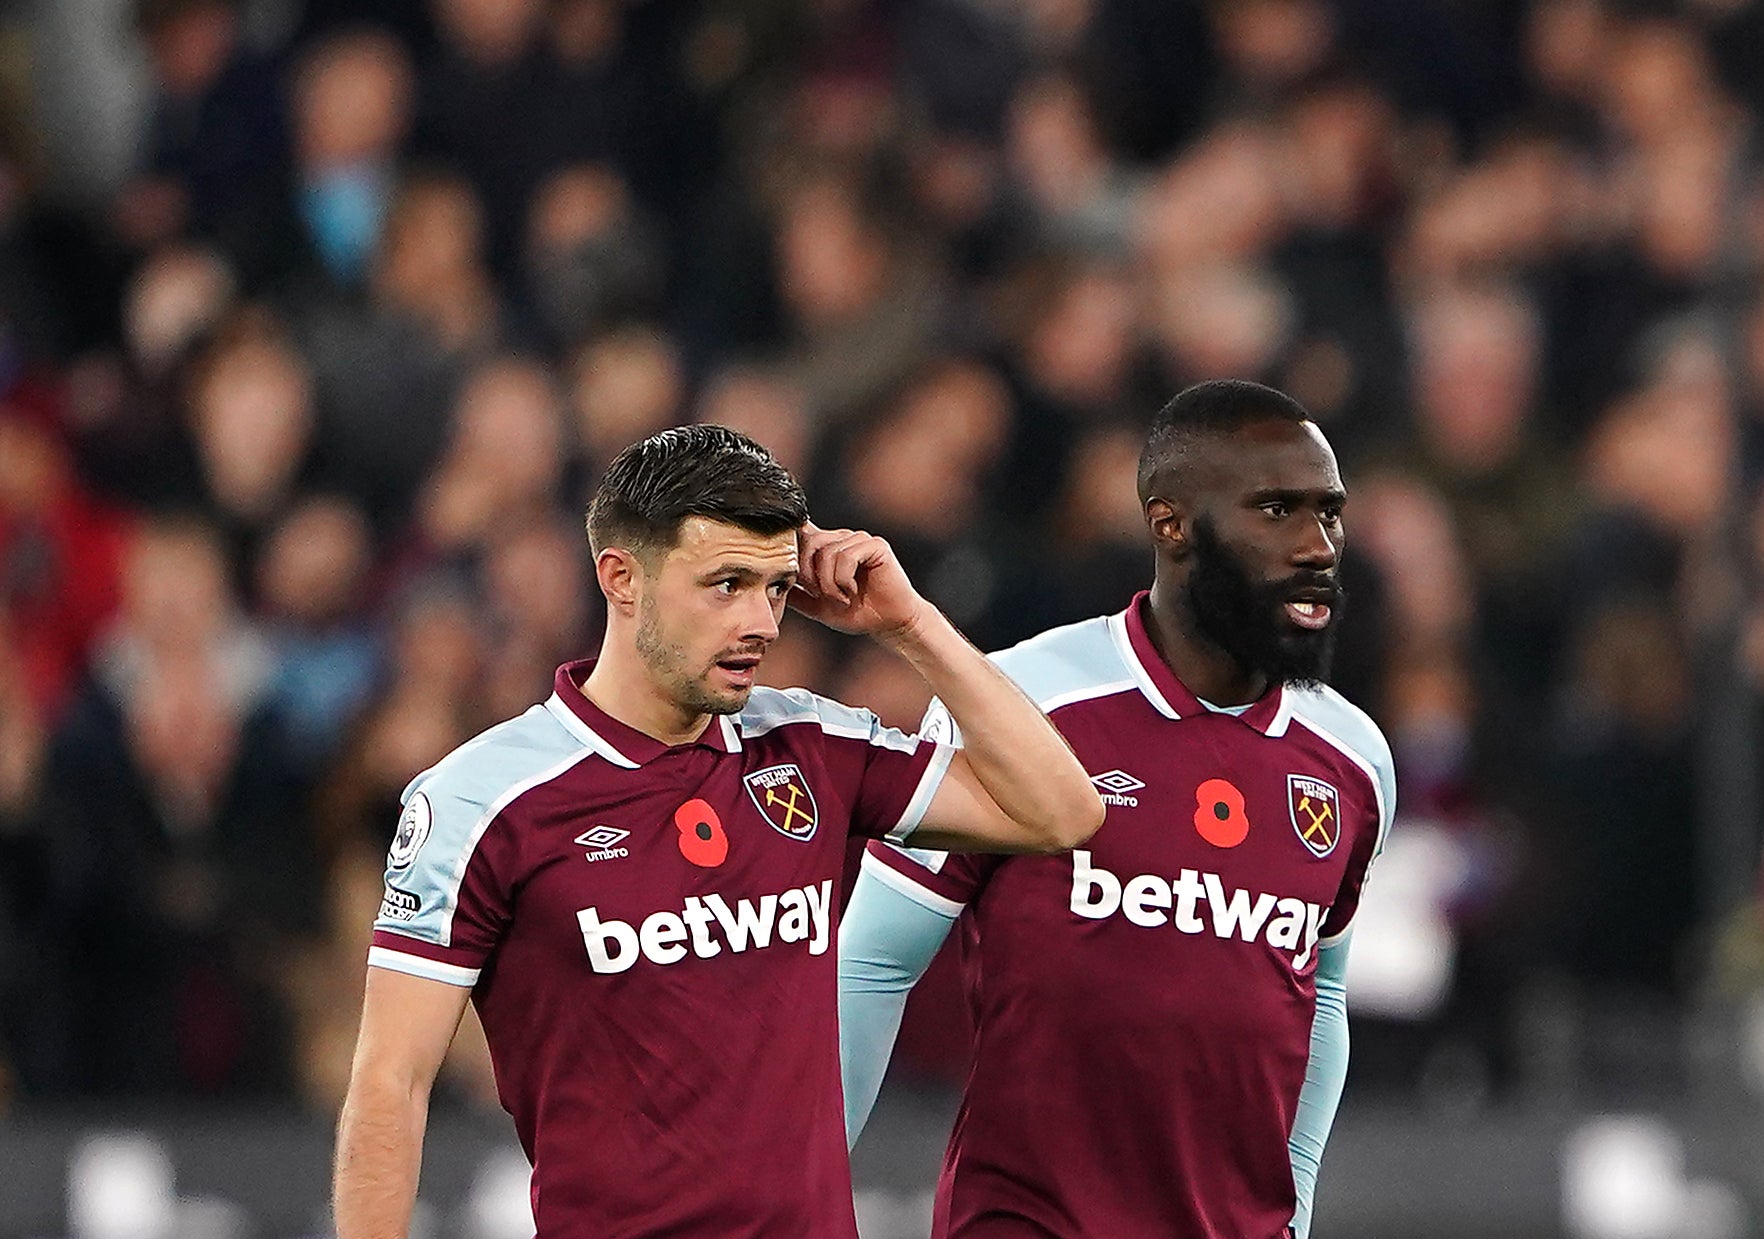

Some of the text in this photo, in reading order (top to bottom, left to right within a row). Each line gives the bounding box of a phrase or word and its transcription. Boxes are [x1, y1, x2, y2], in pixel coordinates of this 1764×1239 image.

[585, 847, 629, 862] umbro
[576, 879, 833, 974] betway
[1070, 850, 1329, 970] betway
